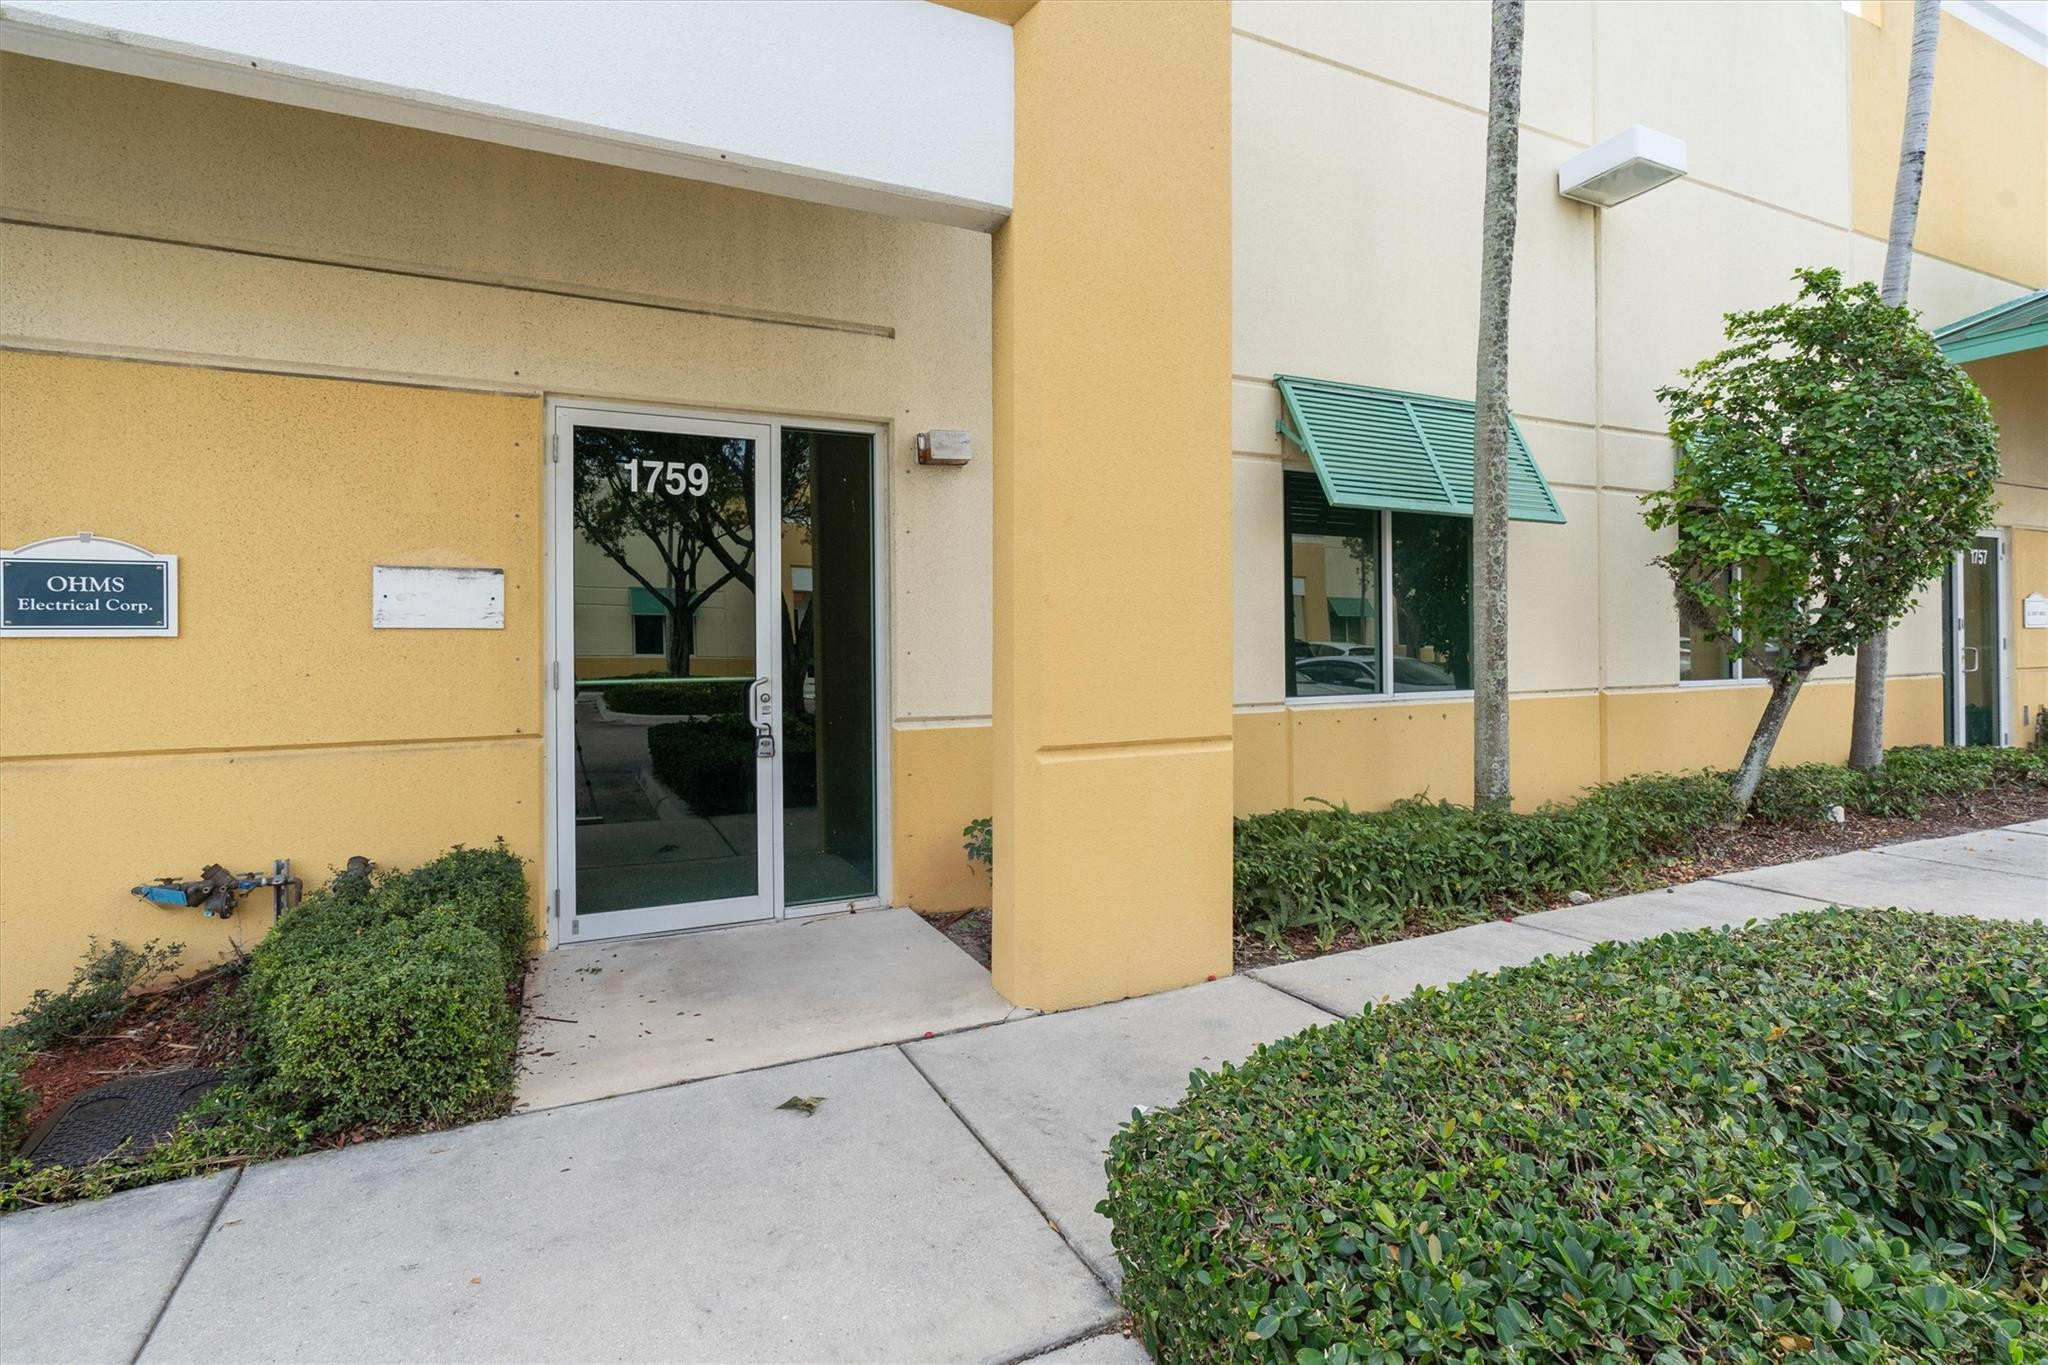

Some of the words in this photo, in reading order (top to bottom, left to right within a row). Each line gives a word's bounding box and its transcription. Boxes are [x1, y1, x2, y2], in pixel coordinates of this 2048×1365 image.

[624, 458, 709, 497] 1759
[1970, 549, 1988, 565] 1757
[47, 575, 125, 593] OHMS
[17, 597, 100, 611] Electrical
[105, 598, 153, 614] Corp.
